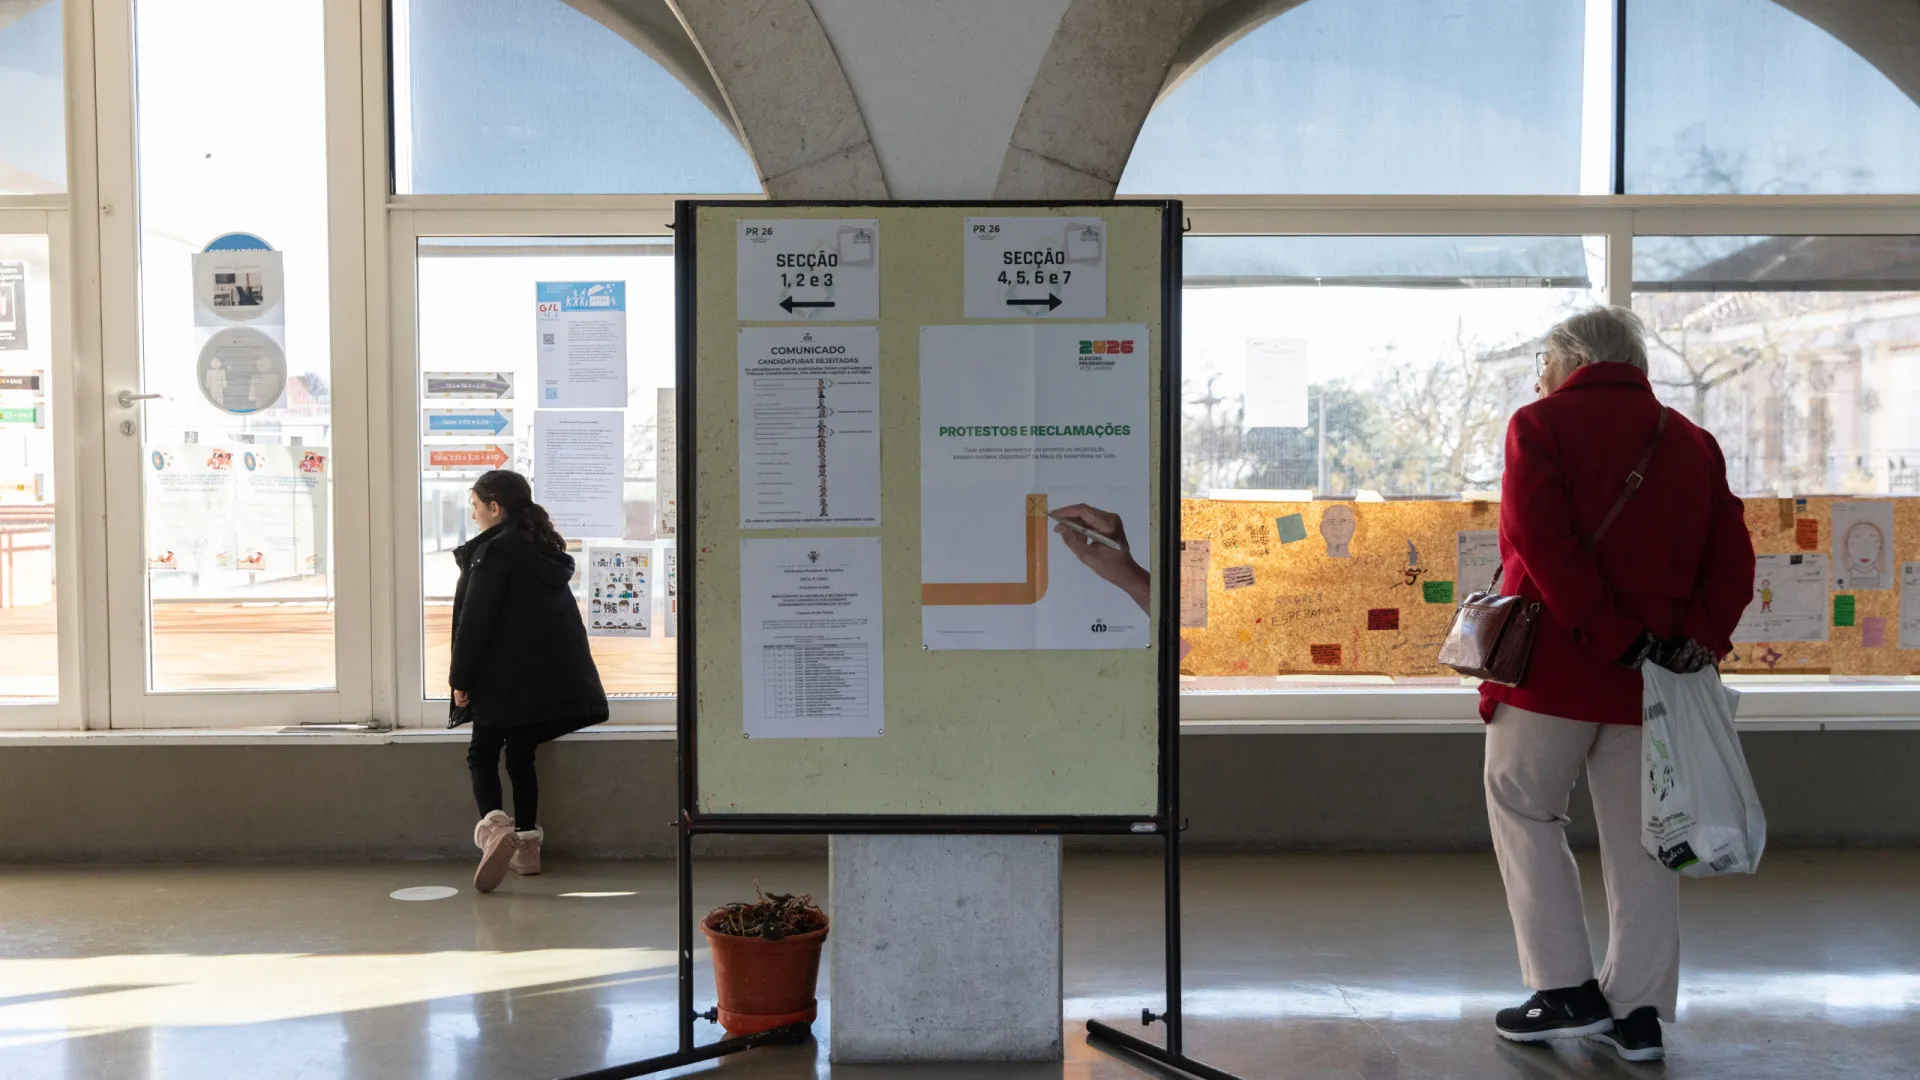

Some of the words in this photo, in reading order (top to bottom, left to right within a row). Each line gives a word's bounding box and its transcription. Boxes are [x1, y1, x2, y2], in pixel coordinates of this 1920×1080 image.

[746, 227, 759, 235] PR
[761, 227, 773, 235] 26
[973, 225, 986, 233] PR
[988, 225, 1001, 233] 26
[776, 250, 838, 271] SECÇÃO
[1003, 248, 1065, 268] SECÇÃO
[781, 273, 791, 288] 1,
[796, 273, 805, 287] 2
[810, 276, 819, 287] e
[824, 273, 833, 287] 3
[997, 271, 1012, 286] 4,
[1016, 271, 1030, 286] 5,
[1034, 271, 1044, 284] 6
[1049, 273, 1058, 284] e
[1062, 271, 1071, 284] 7
[771, 346, 846, 355] COMUNICADO
[1079, 340, 1134, 354] 2026
[939, 425, 1018, 437] PROTESTOS
[1020, 425, 1028, 436] E
[1030, 422, 1131, 438] RECLAMAÇÕES
